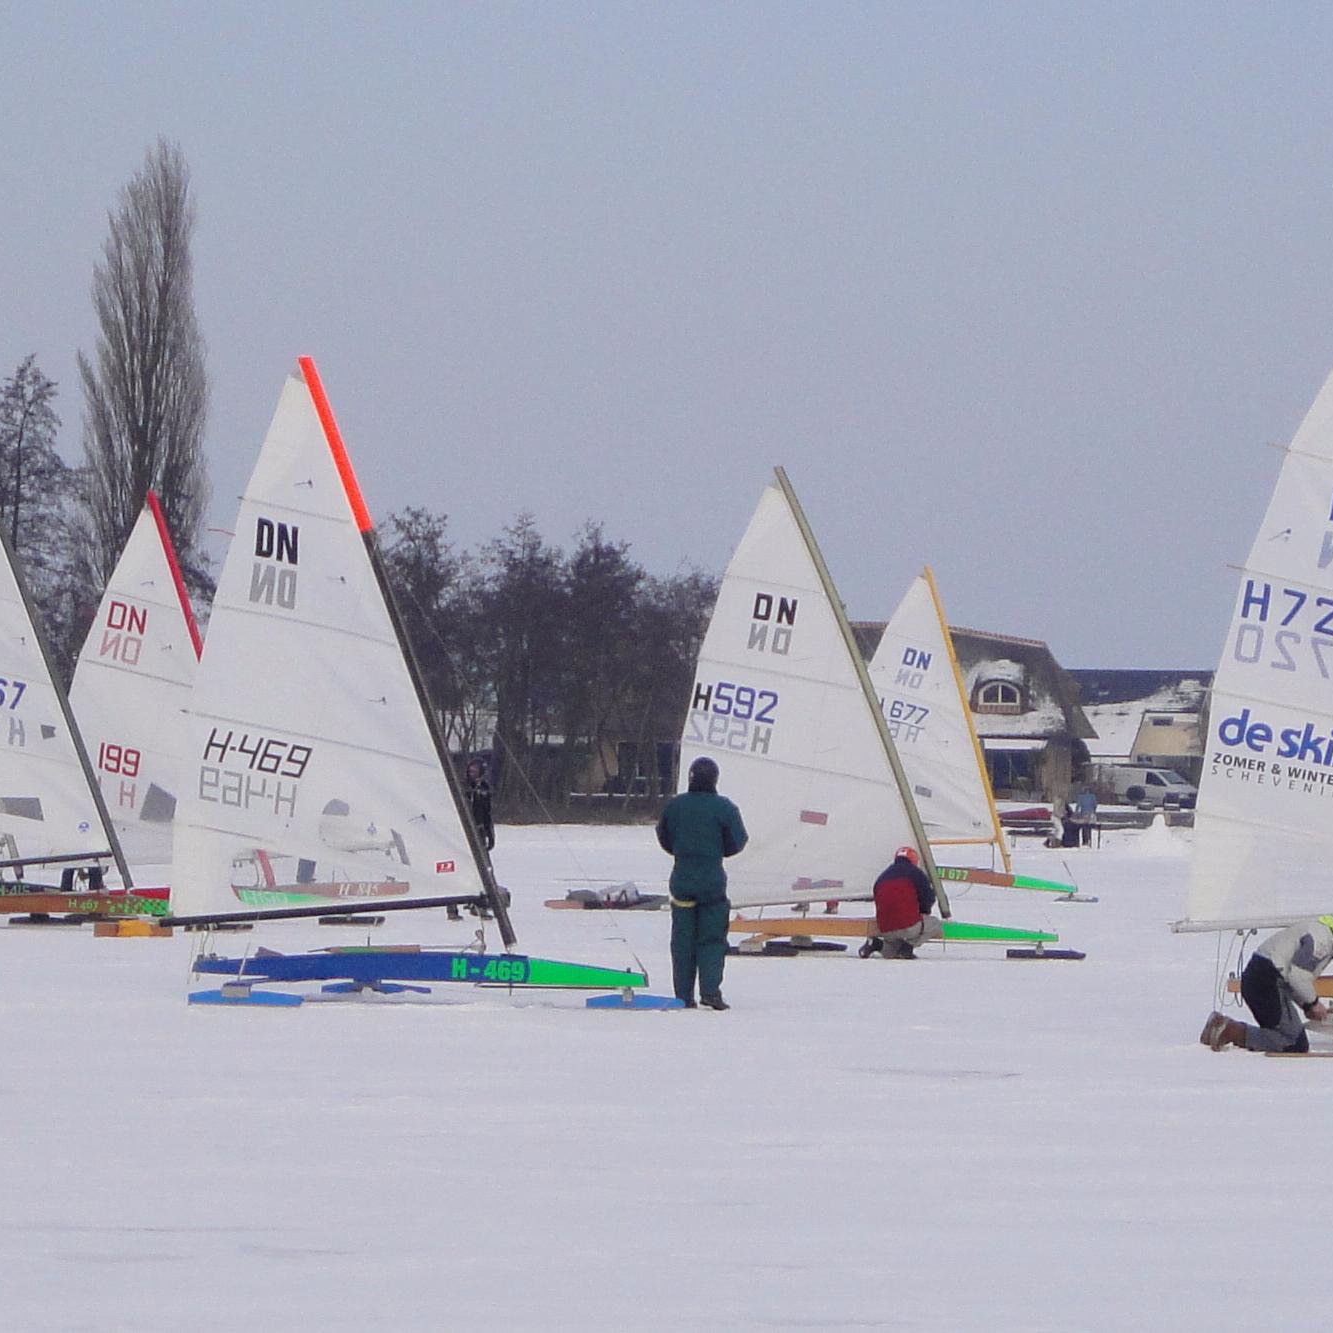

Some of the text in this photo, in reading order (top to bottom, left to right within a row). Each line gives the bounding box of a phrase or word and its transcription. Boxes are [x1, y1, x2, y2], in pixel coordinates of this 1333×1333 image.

[255, 517, 299, 565] DN
[106, 601, 147, 635] DN
[753, 592, 798, 626] DN
[902, 647, 932, 671] DN
[692, 682, 779, 725] H592
[890, 700, 929, 724] 677
[1218, 708, 1273, 752] de
[98, 742, 141, 777] 199
[203, 727, 313, 779] H-469
[1213, 752, 1266, 773] ZOMER
[1271, 763, 1282, 775] &
[948, 869, 969, 880] 677
